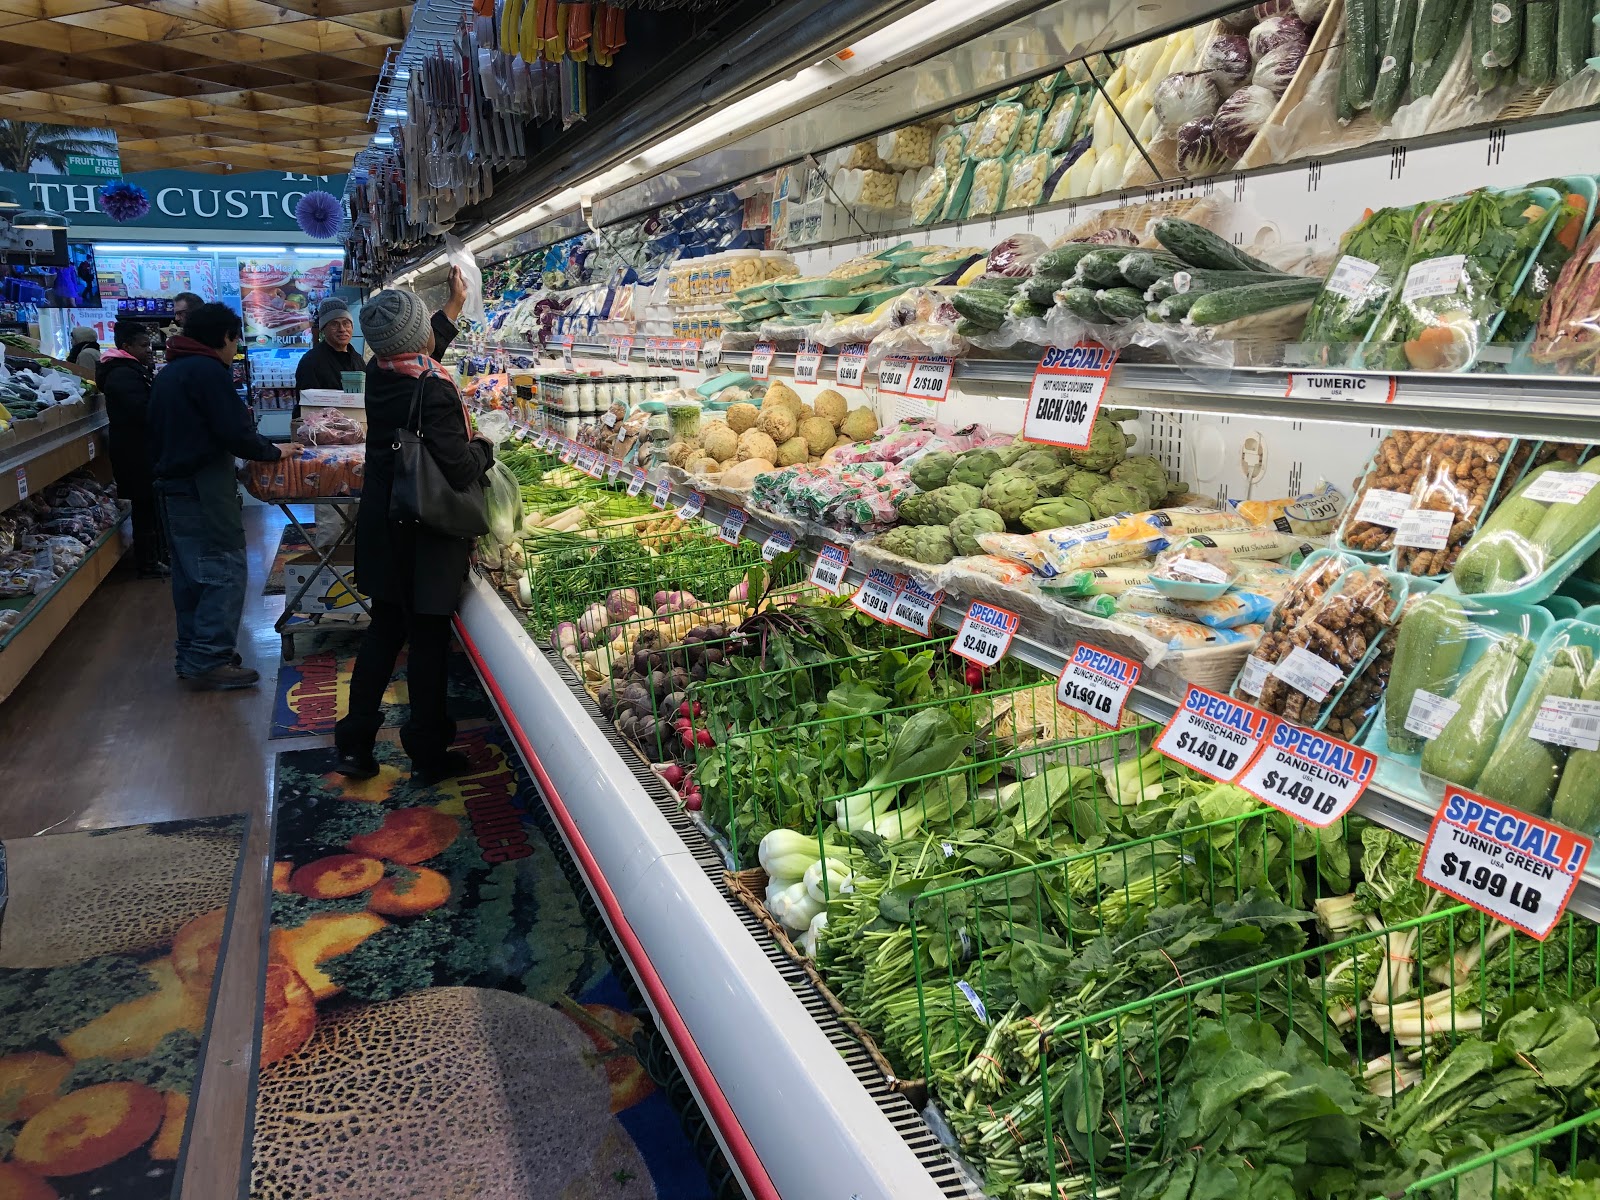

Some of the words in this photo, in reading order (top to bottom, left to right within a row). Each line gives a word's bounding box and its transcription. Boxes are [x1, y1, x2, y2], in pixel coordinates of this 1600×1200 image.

[69, 156, 95, 166] FRUIT
[96, 158, 119, 168] TREE
[95, 166, 120, 176] FARM
[29, 183, 107, 214] TH
[245, 263, 271, 273] Fresh
[79, 311, 104, 320] Sharp
[271, 335, 298, 345] FRUIT
[894, 373, 902, 385] LB
[913, 376, 943, 392] 2/$1.00
[1307, 378, 1367, 390] TUMERIC
[1042, 380, 1052, 391] HOT
[1052, 381, 1067, 392] HOUSE
[1067, 381, 1094, 394] CUCUMBER
[1187, 526, 1203, 534] tofu
[1108, 552, 1123, 561] tofu
[1233, 545, 1250, 554] tofu
[1124, 577, 1141, 586] tofu
[862, 591, 880, 609] $1.99
[879, 599, 888, 614] LB
[903, 593, 930, 610] ARUGULA
[963, 633, 987, 655] $2.49
[986, 643, 998, 659] LB
[1073, 666, 1094, 681] BUNCH
[1093, 675, 1121, 692] SPINACH
[1064, 680, 1096, 706] $1.99
[1095, 694, 1112, 714] LB
[1188, 715, 1248, 746] SWISSCHARD
[1176, 731, 1218, 762] $1.49
[1216, 748, 1239, 771] LB
[1276, 751, 1349, 790] DANDELION
[1302, 774, 1313, 783] USA
[1262, 770, 1315, 805] $1.49
[1312, 791, 1338, 815] LB
[457, 769, 535, 865] Produce
[1452, 828, 1502, 857] TURNIP
[1504, 851, 1554, 880] GREEN
[1490, 858, 1504, 870] USA
[1440, 851, 1508, 898] $1.99
[1509, 881, 1542, 914] LB
